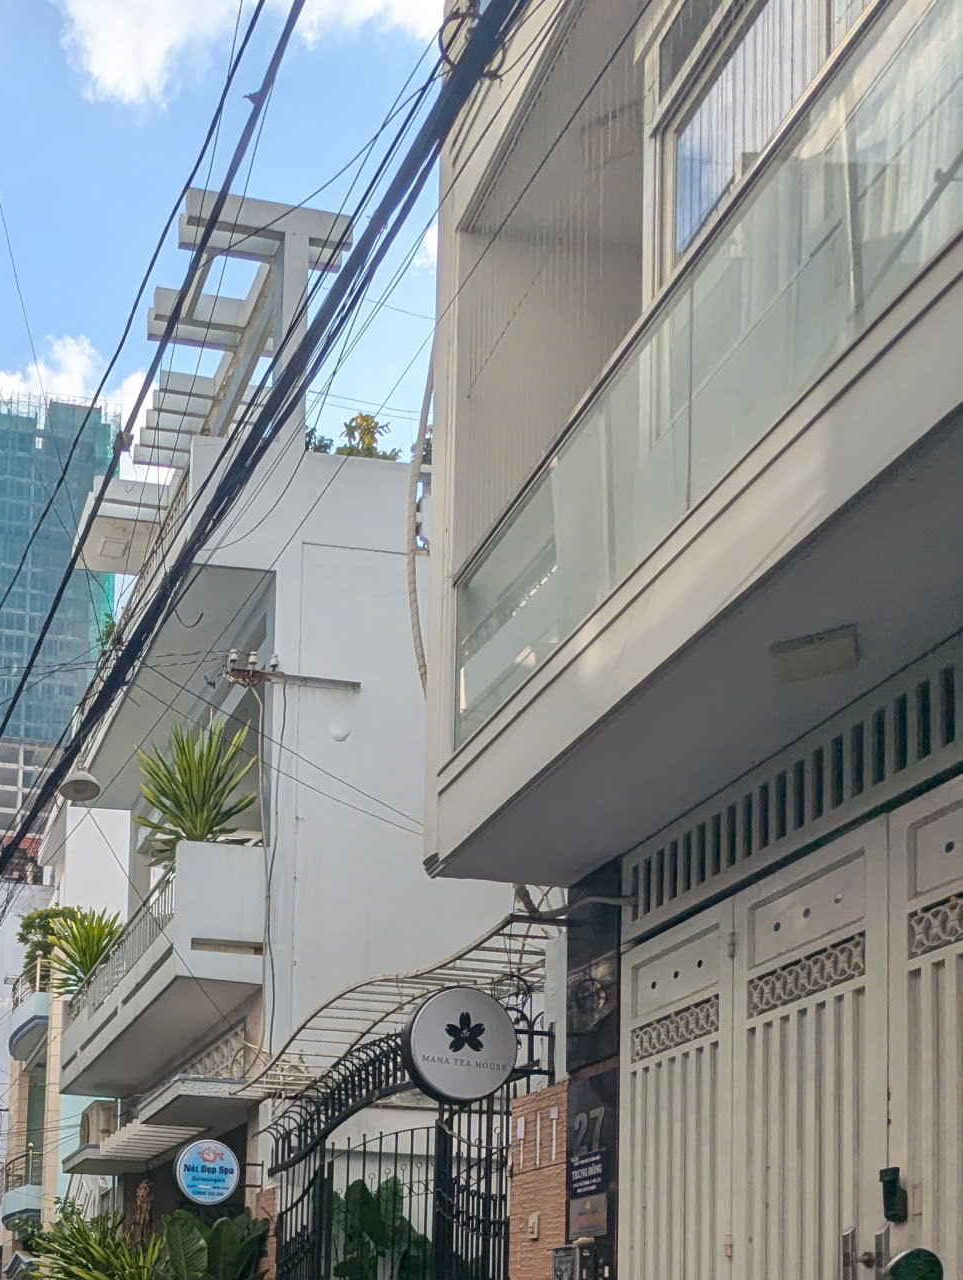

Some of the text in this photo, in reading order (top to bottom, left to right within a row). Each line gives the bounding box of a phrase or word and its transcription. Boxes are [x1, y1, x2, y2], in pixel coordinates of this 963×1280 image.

[421, 1055, 507, 1072] MANA TEA HOUSE
[573, 1096, 606, 1157] 27
[184, 1164, 200, 1173] Nét
[218, 1166, 234, 1176] Spa
